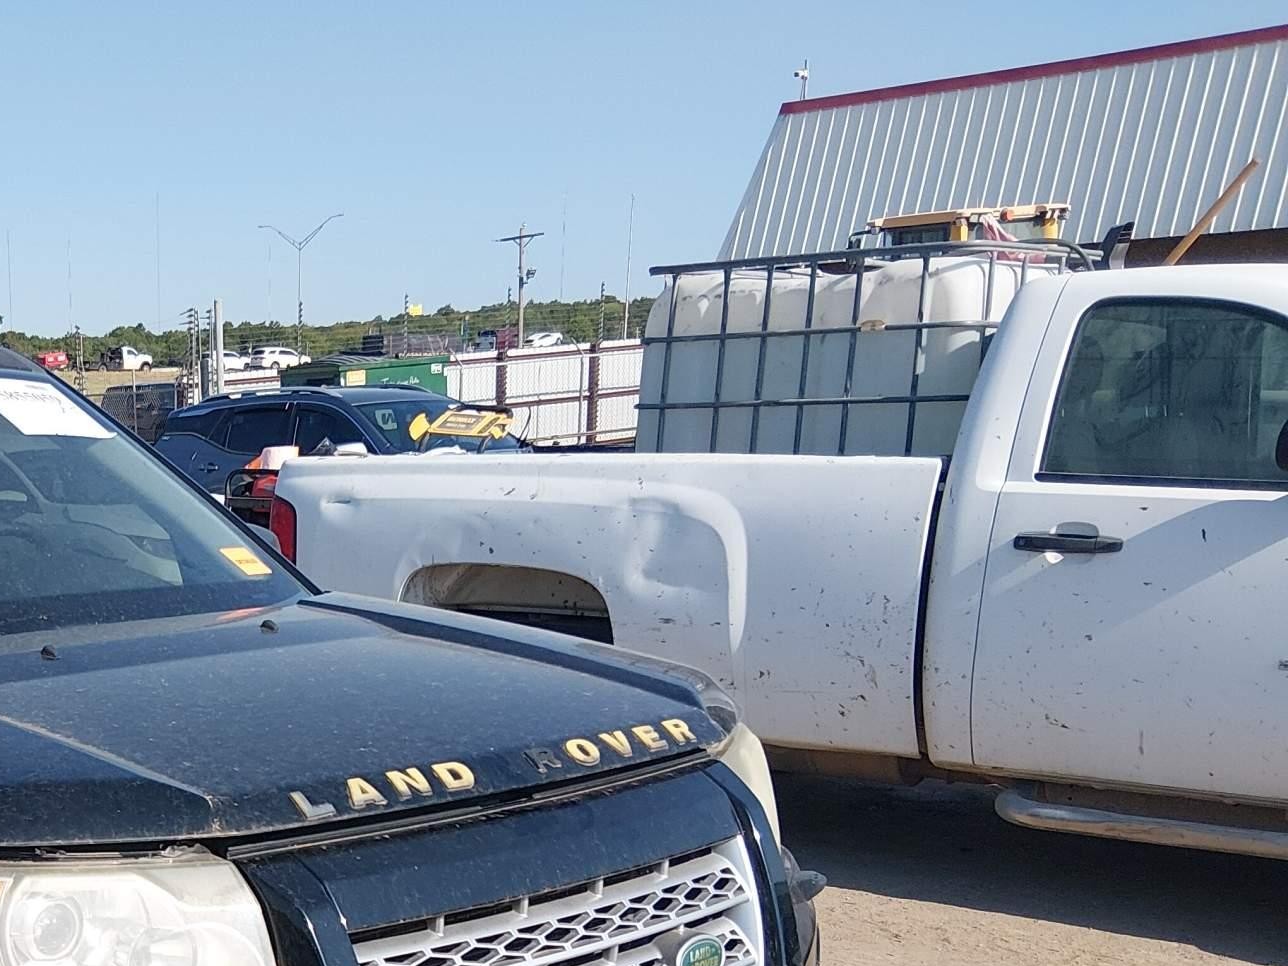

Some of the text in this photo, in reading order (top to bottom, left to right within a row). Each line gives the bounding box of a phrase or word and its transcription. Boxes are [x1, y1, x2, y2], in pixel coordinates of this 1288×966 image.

[288, 718, 697, 820] LAND ROVER
[689, 946, 712, 962] LAND
